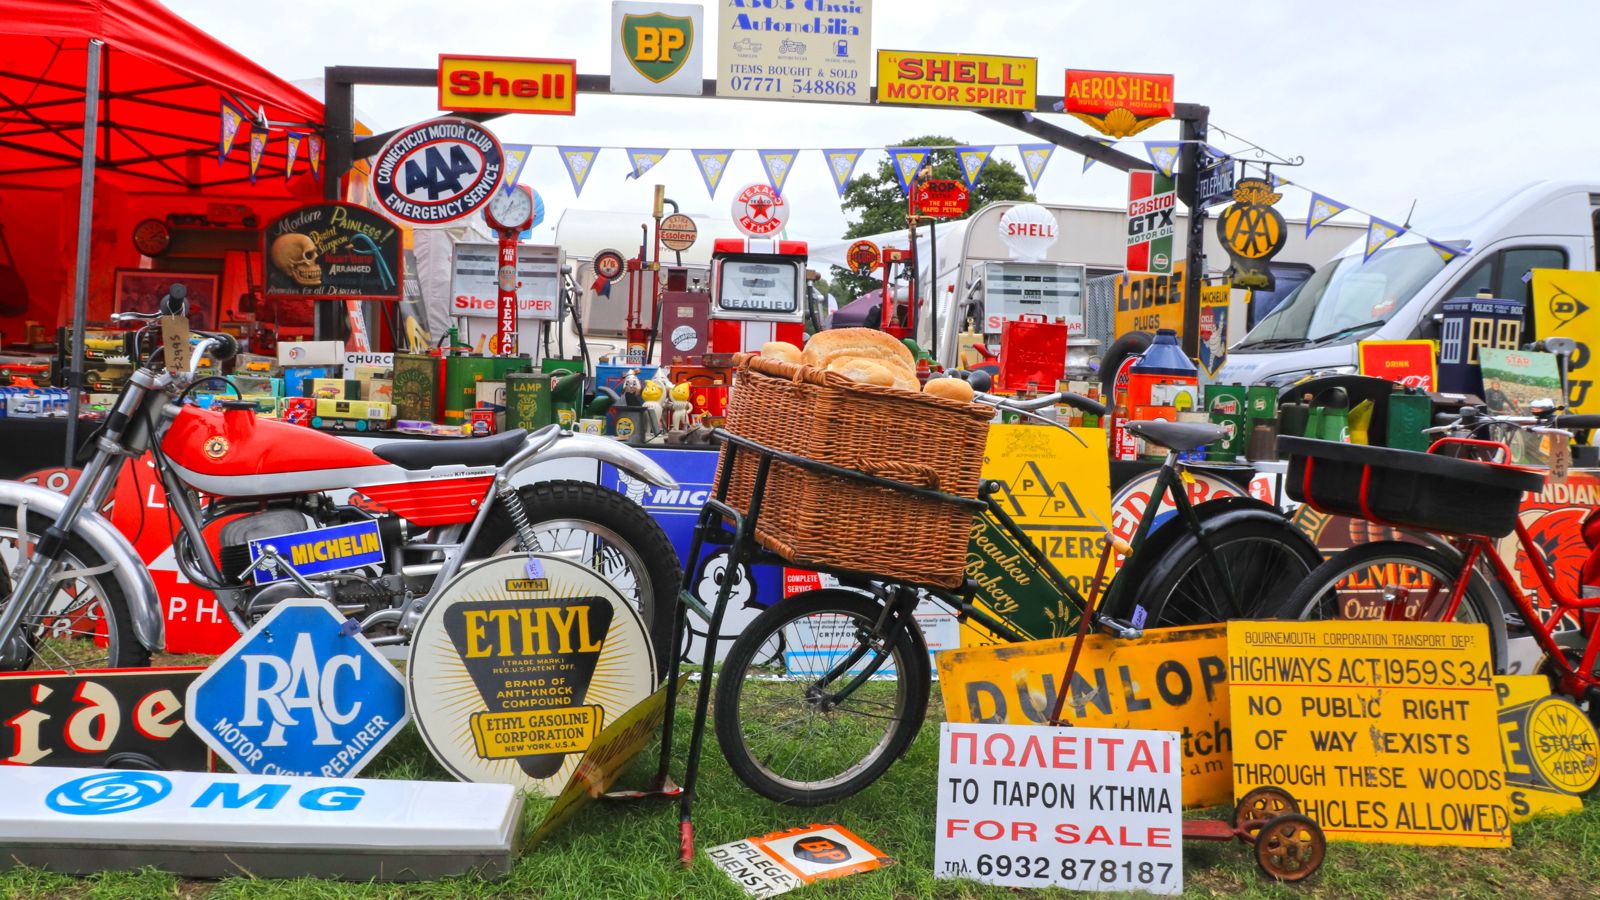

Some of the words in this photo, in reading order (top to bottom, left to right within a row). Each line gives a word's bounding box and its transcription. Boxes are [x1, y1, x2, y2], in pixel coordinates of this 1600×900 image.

[804, 0, 864, 14] Classic
[731, 13, 860, 36] Automobilia
[634, 26, 685, 63] BP
[730, 64, 763, 74] ITEMS
[768, 66, 812, 77] BOUGHT
[818, 69, 824, 77] &
[830, 69, 858, 79] SOLD
[449, 70, 565, 99] Shell
[731, 76, 782, 92] 07771
[792, 79, 857, 96] 548868
[887, 82, 961, 102] MOTOR
[966, 86, 1027, 105] SPIRIT
[1069, 77, 1171, 102] AEROSHELL
[1129, 101, 1163, 109] MOTEURS
[378, 129, 431, 184] CONNECTICUT
[428, 124, 466, 139] MOTOR
[466, 127, 494, 153] CLUB
[404, 145, 478, 200] AAA
[385, 193, 463, 220] EMERGENCY
[463, 162, 500, 207] SERVICE
[930, 182, 955, 191] ROP
[1200, 170, 1233, 199] TELEPHONE
[741, 185, 783, 205] TEXACO
[1129, 192, 1175, 217] Castrol
[741, 218, 780, 232] ETHYL
[1008, 223, 1055, 238] SHELL
[1128, 208, 1174, 235] GTX
[660, 231, 696, 241] Essolene
[1127, 231, 1157, 245] MOTOR
[1160, 227, 1174, 237] OIL
[329, 264, 371, 276] ARRANGED
[1118, 271, 1182, 312] LODGE
[1201, 292, 1228, 303] MICHELIN
[455, 296, 496, 309] She
[519, 300, 552, 311] UPER
[722, 299, 793, 310] BEAULIEU
[1471, 303, 1493, 312] POLICE
[1510, 306, 1524, 314] BOX
[1554, 303, 1574, 313] D
[502, 296, 513, 355] TEXAC
[1134, 314, 1160, 331] PLUGS
[347, 354, 394, 364] CHURC
[630, 348, 646, 356] ESSO
[513, 383, 542, 392] LAMP
[518, 422, 535, 430] OIL
[1023, 479, 1034, 491] P
[652, 489, 711, 506] MIC
[1054, 501, 1066, 513] P
[290, 532, 380, 566] MICHELIN
[969, 515, 1031, 586] Beaulieu
[1040, 536, 1106, 559] IZERS
[512, 580, 544, 590] WITH
[963, 552, 1020, 614] Bakery
[463, 605, 602, 659] ETHYL
[1245, 631, 1316, 646] BOURNEMOUTH
[1323, 632, 1388, 646] CORPORATION
[1392, 634, 1446, 647] TRANSPORT
[502, 658, 534, 666] (TRADE
[536, 658, 565, 666] MARK)
[1229, 656, 1332, 684] HIGHWAYS
[239, 632, 362, 746] RAC
[496, 687, 573, 698] ANTI-KNOCK
[505, 678, 546, 688] BRAND
[551, 677, 565, 686] OF
[965, 655, 1228, 724] DUNLOP
[502, 697, 571, 709] COMPOUND
[1248, 695, 1282, 716] NO
[1301, 696, 1382, 719] PUBLIC
[1403, 699, 1470, 721] RIGHT
[486, 717, 525, 731] ETHYL
[530, 712, 589, 728] GASOLINE
[1550, 713, 1568, 727] IN
[213, 717, 264, 766] MOTOR
[320, 715, 390, 777] REPAIRER
[494, 728, 584, 744] CORPORATION
[1182, 720, 1232, 758] tch
[1255, 729, 1287, 751] OF
[1310, 730, 1358, 752] WAY
[1383, 732, 1470, 755] EXISTS
[1539, 734, 1593, 753] STOCK
[505, 744, 524, 752] NEW
[950, 732, 1171, 774] ΠΩΛΕΙΤΑΙ
[1234, 763, 1326, 786] THROUGH
[1334, 765, 1408, 789] THESE
[1419, 768, 1502, 791] WOODS
[1554, 760, 1590, 775] HERE
[191, 782, 366, 812] MG
[949, 777, 979, 804] ΤΟ
[993, 780, 1075, 809] ΠΑΡΟΝ
[1090, 785, 1173, 814] ΚΤΗΜΑ
[1395, 802, 1510, 833] ALLOWED
[946, 819, 1038, 842] FOR
[1054, 823, 1173, 848] SALE
[799, 840, 846, 861] BP
[709, 849, 773, 893] DIENST
[730, 843, 792, 887] PFLEGE-
[976, 854, 1050, 879] 6932
[1060, 858, 1174, 885] 878187
